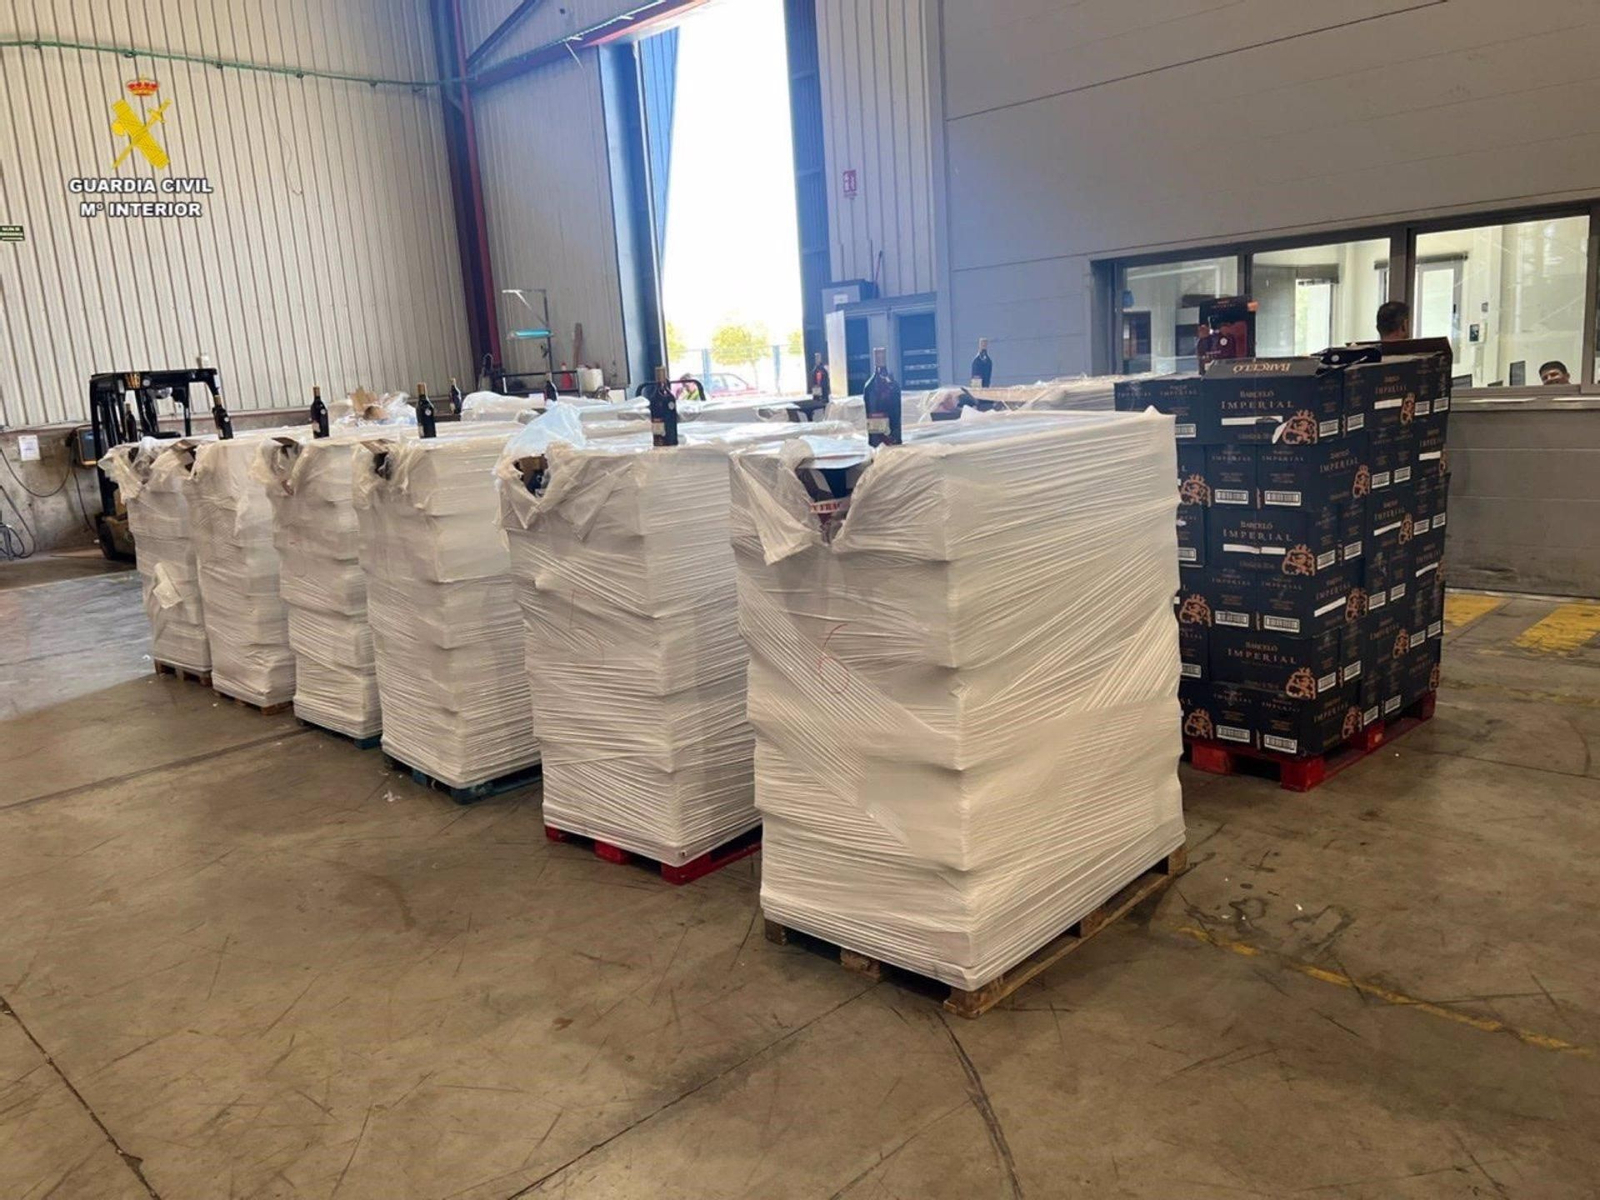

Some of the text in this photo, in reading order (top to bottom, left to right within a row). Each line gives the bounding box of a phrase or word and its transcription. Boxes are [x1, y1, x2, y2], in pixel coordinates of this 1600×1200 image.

[1221, 400, 1295, 410] IMPERIAL
[1320, 456, 1359, 473] IMPERIAL
[1223, 528, 1294, 542] IMPERIAL
[1228, 647, 1298, 665] IMPERIAL
